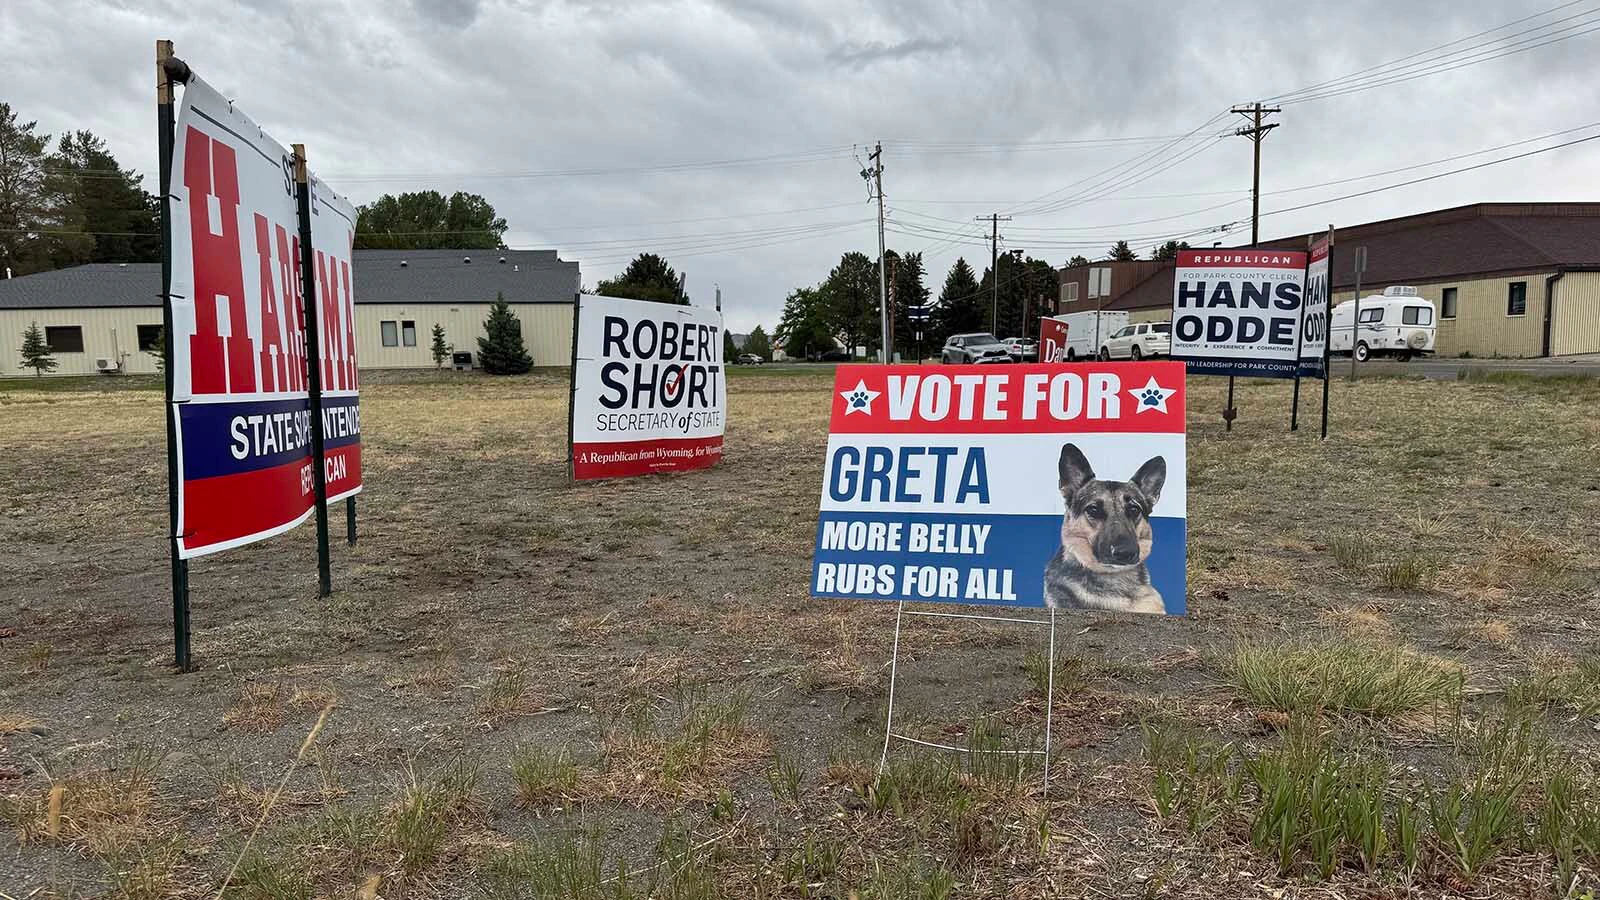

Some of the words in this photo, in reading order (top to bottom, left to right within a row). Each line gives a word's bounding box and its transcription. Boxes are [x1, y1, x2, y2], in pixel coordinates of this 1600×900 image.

[1194, 255, 1292, 265] REPUBLICAN
[1269, 273, 1298, 281] CLERK
[1178, 281, 1302, 310] HANS
[603, 315, 718, 362] ROBERT
[1175, 315, 1296, 345] ODDE
[1196, 361, 1233, 369] LEADERSHIP
[1248, 362, 1266, 370] PARK
[1268, 363, 1297, 372] COUNTY
[598, 362, 720, 410] SHORT
[887, 374, 1009, 421] VOTE
[1022, 372, 1121, 420] FOR
[230, 412, 294, 460] STATE
[596, 412, 679, 431] SECRETARY
[678, 411, 693, 433] of
[693, 410, 720, 428] STATE
[579, 452, 588, 463] A
[590, 449, 638, 465] Republican
[639, 448, 655, 460] from
[656, 447, 694, 460] Wyoming,
[695, 446, 705, 457] for
[829, 446, 991, 504] GRETA
[821, 520, 902, 552] MORE
[908, 523, 992, 555] BELLY
[816, 563, 896, 595] RUBS
[902, 565, 960, 598] FOR
[965, 568, 1017, 601] ALL
